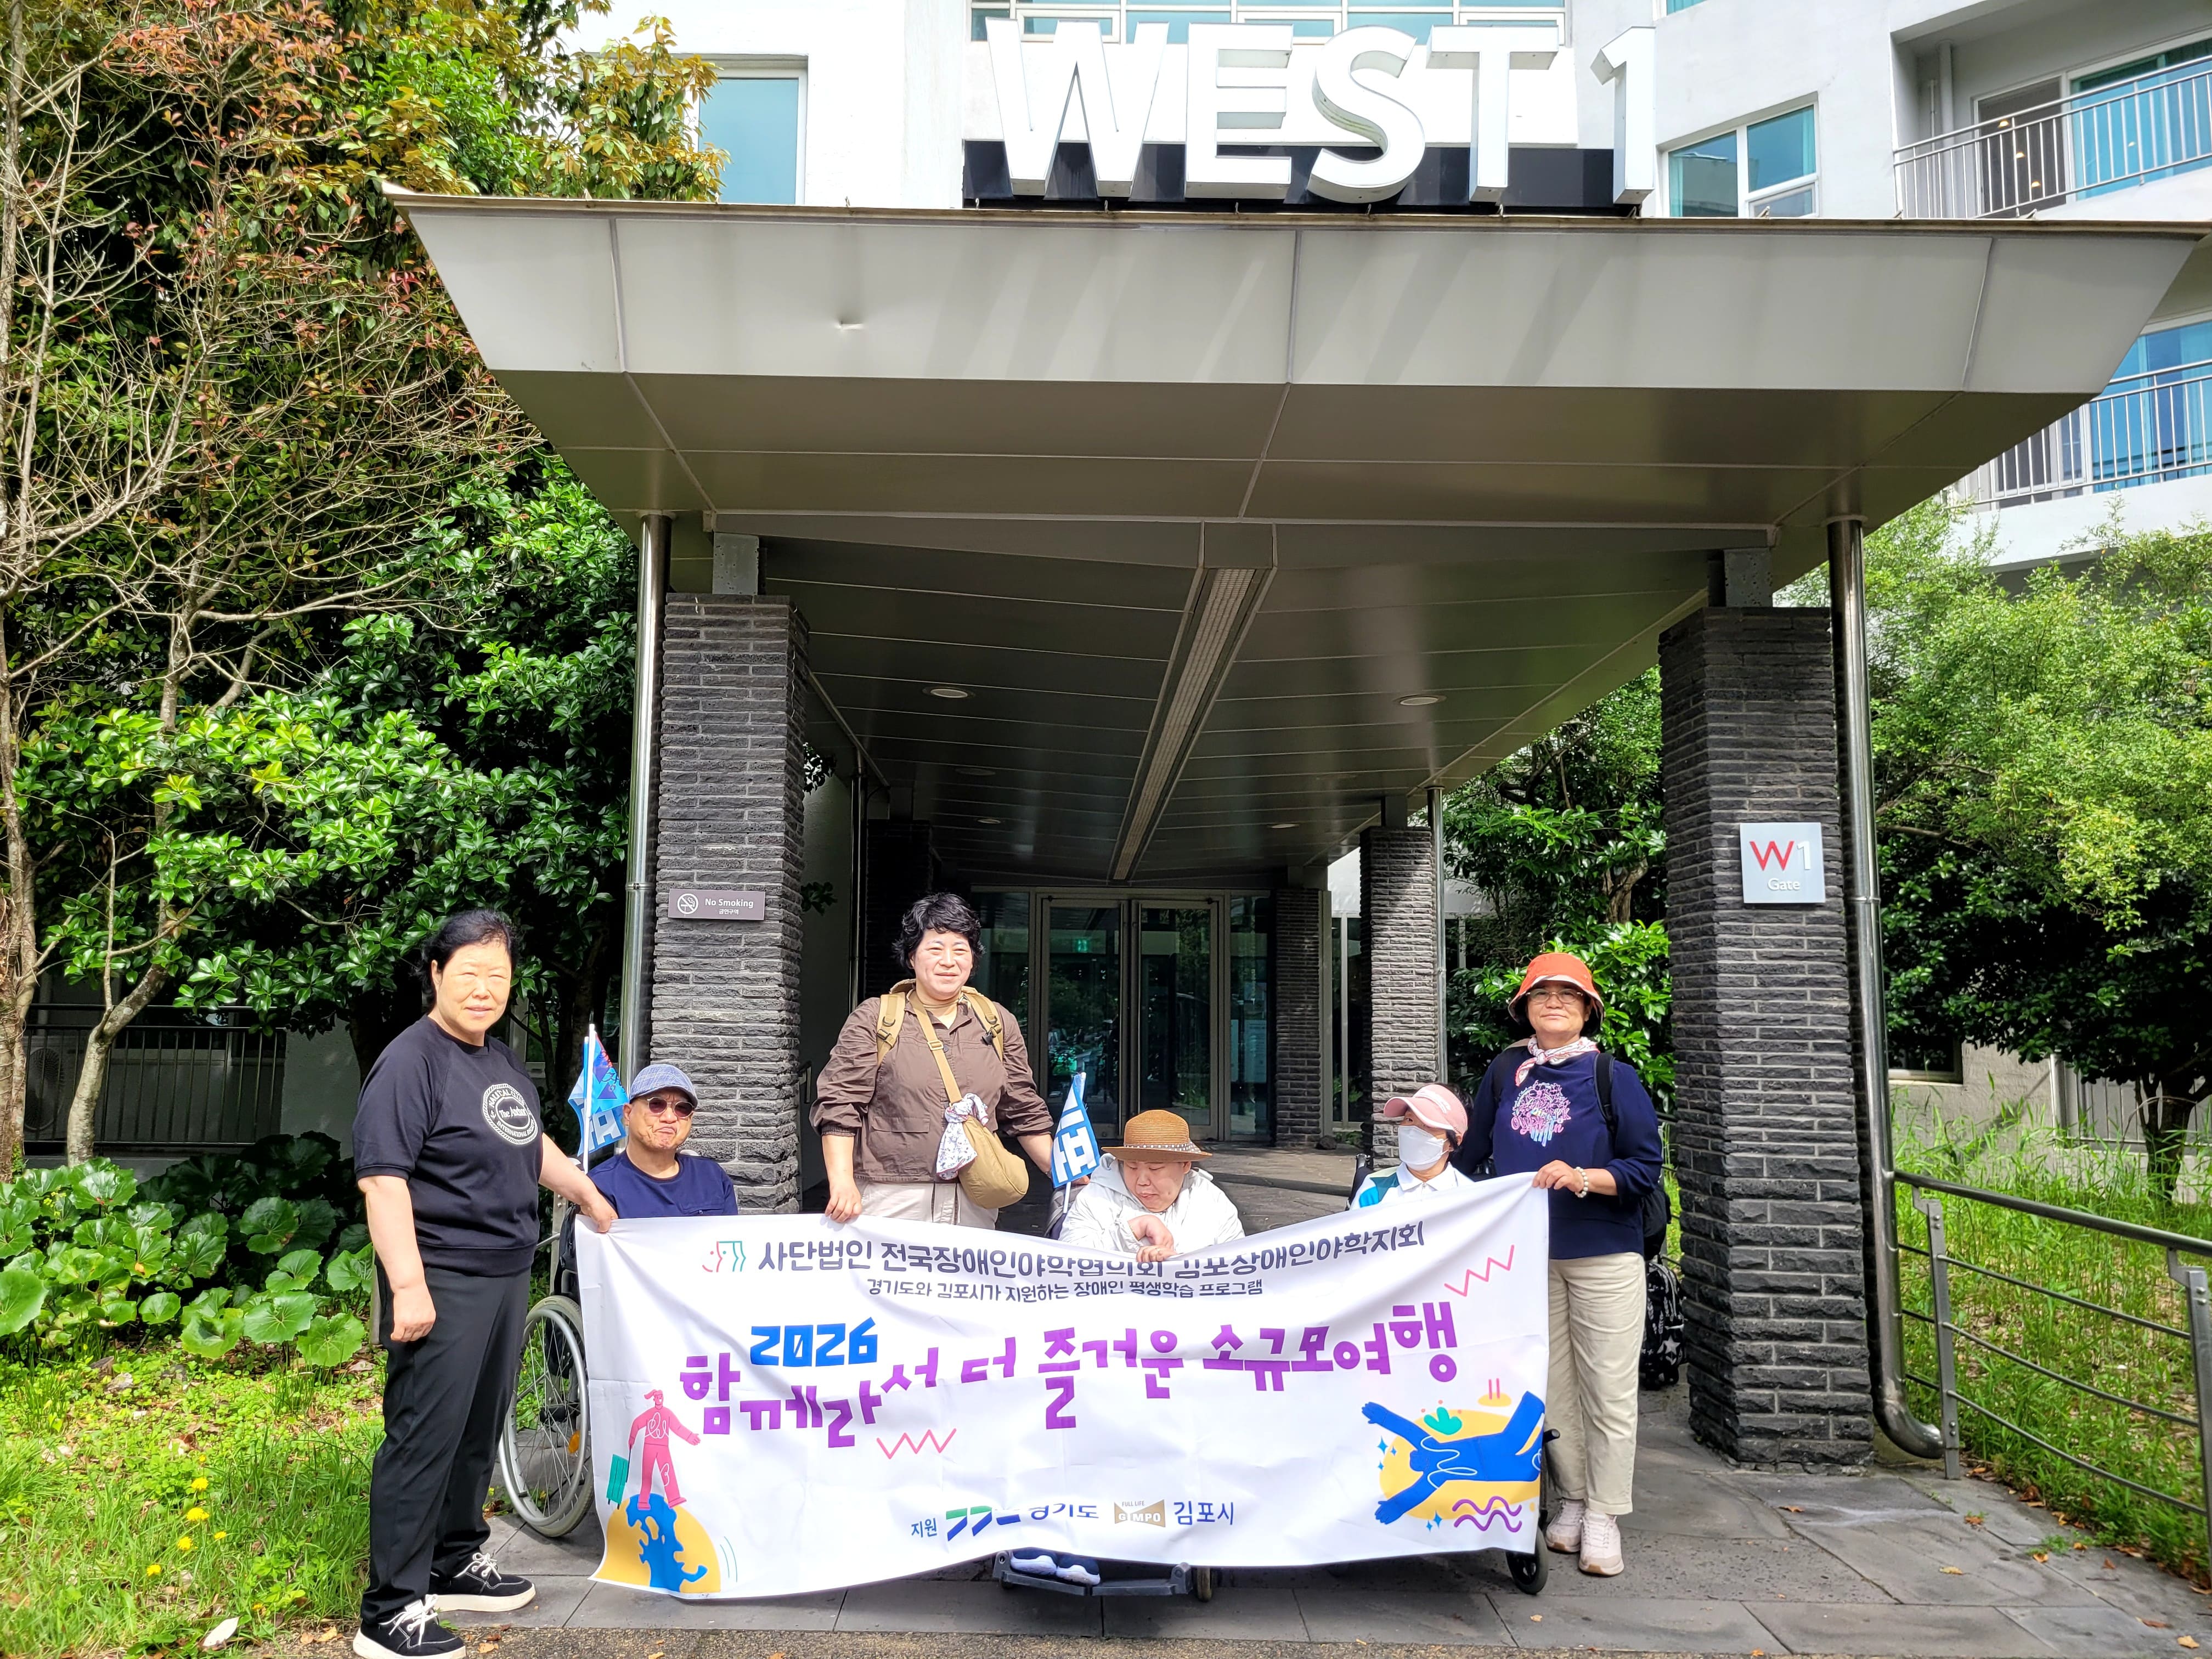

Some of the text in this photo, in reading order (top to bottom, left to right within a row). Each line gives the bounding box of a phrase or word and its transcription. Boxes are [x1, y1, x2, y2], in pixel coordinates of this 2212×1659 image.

[985, 17, 1656, 204] WEST 1
[1749, 840, 1811, 871] W1
[1768, 877, 1800, 890] Gate
[718, 899, 754, 909] Smoking
[499, 1109, 511, 1119] The
[758, 1240, 872, 1271] 사단법인
[867, 1279, 1263, 1303] 경기도와 김포시가 지원하는 장애인 평생학습 프로그램
[751, 1317, 878, 1367] 2026
[680, 1302, 1458, 1448] 함께라서 더 즐거운 소규모여행
[1173, 1500, 1234, 1526] 김포시
[911, 1517, 937, 1538] 지원
